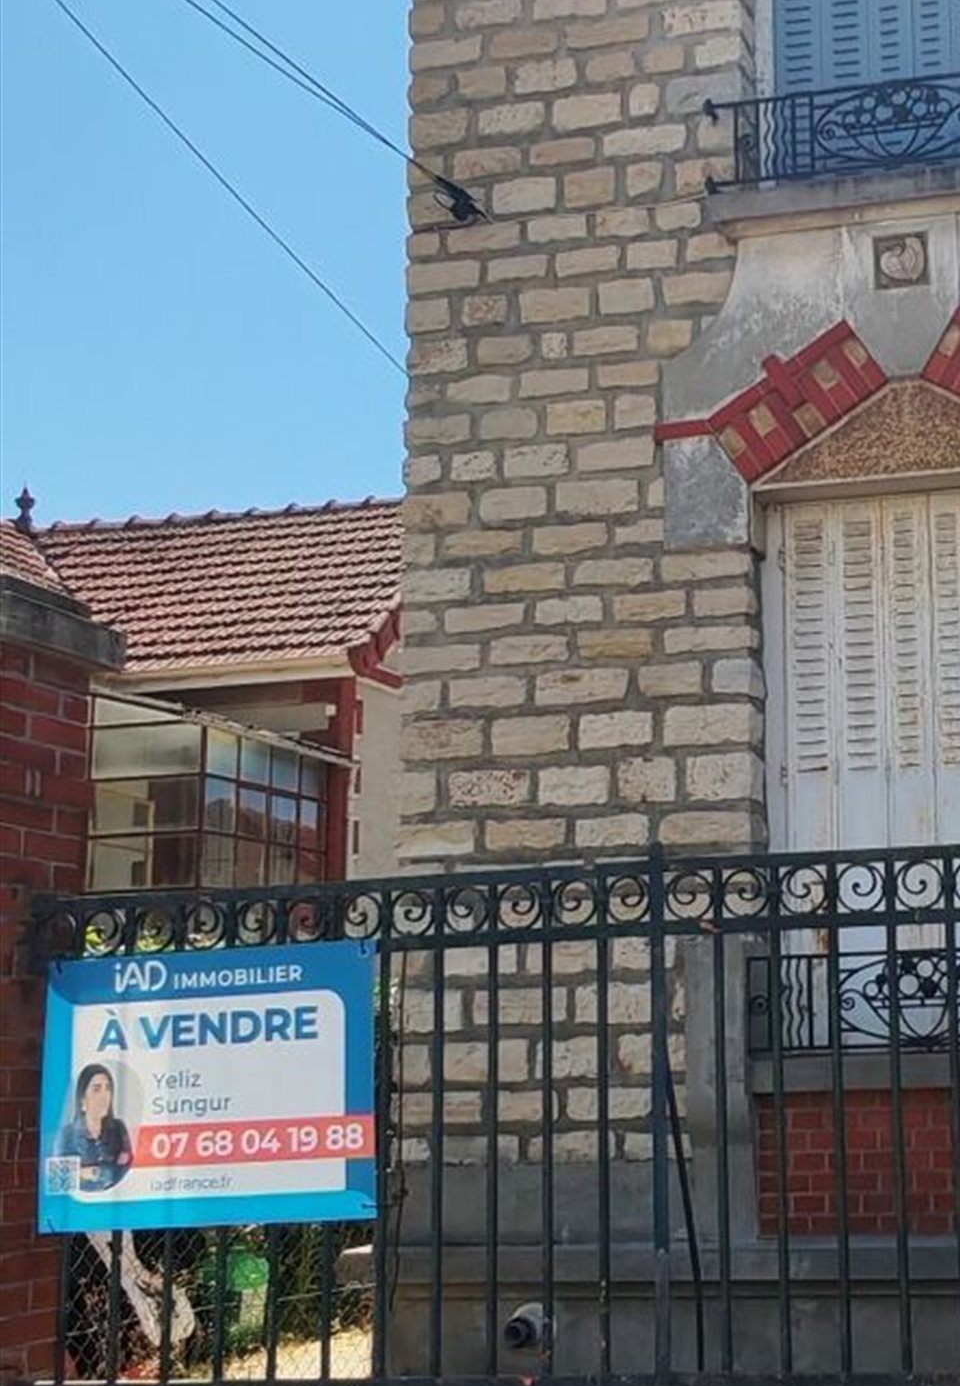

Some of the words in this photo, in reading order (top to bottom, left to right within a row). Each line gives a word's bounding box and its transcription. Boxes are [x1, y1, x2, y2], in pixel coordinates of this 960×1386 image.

[174, 965, 302, 989] IMMOBILIER
[97, 1011, 128, 1051] À
[139, 1006, 319, 1047] VENDRE
[152, 1072, 202, 1089] Yeliz
[152, 1096, 231, 1116] Sungur
[151, 1134, 187, 1159] 07
[196, 1131, 233, 1156] 68
[241, 1129, 282, 1154] 04
[287, 1126, 318, 1152] 19
[326, 1124, 365, 1150] 88
